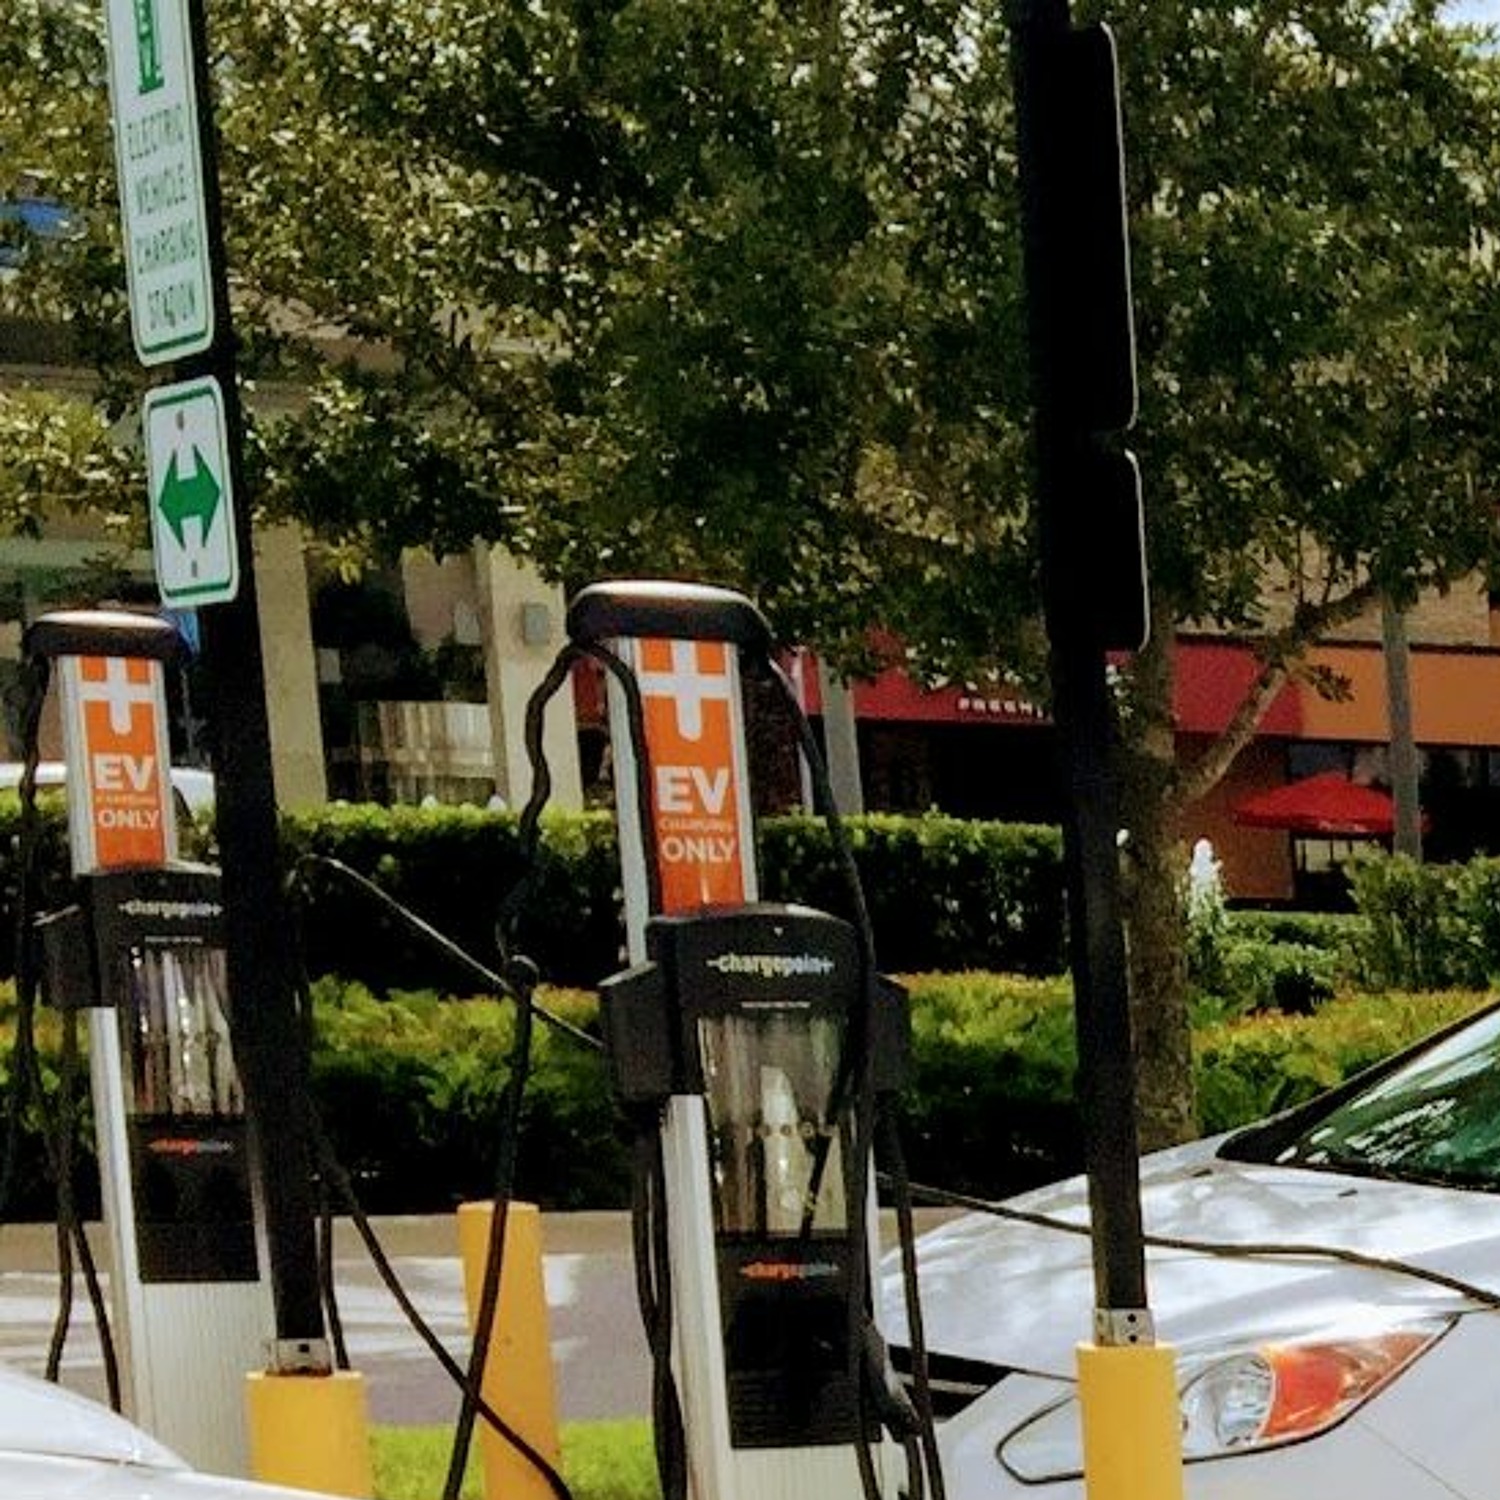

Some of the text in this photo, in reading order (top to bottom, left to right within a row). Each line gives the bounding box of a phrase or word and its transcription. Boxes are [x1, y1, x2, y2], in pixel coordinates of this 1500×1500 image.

[93, 753, 155, 792] EV
[656, 765, 729, 814] EV
[98, 809, 160, 829] ONLY
[662, 836, 735, 863] ONLY
